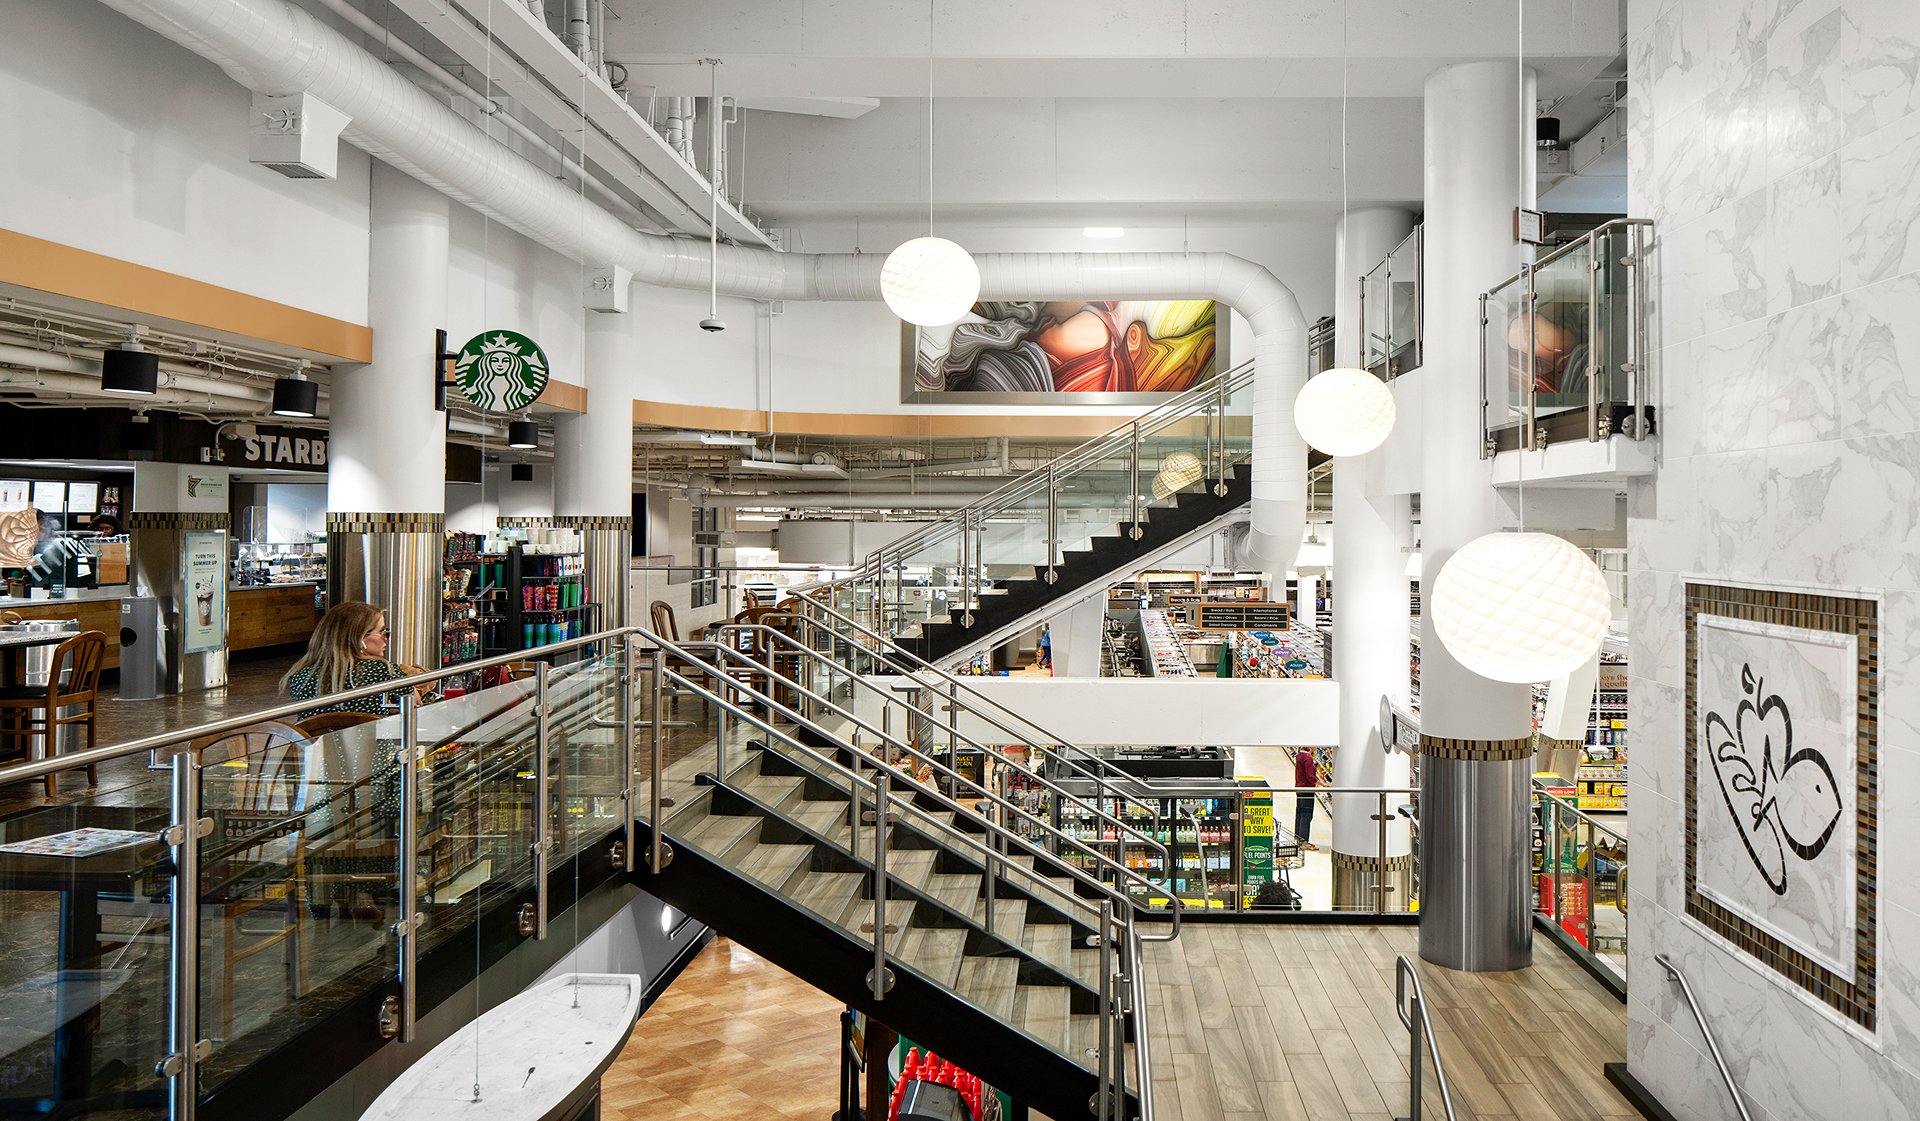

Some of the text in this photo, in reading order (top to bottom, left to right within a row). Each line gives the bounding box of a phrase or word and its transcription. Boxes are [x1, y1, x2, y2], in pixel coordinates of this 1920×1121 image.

[245, 434, 329, 466] STARB
[1191, 609, 1194, 621] 1
[1250, 807, 1270, 816] GREAT
[1250, 817, 1264, 825] WAY
[1244, 825, 1271, 834] TO SAVE!
